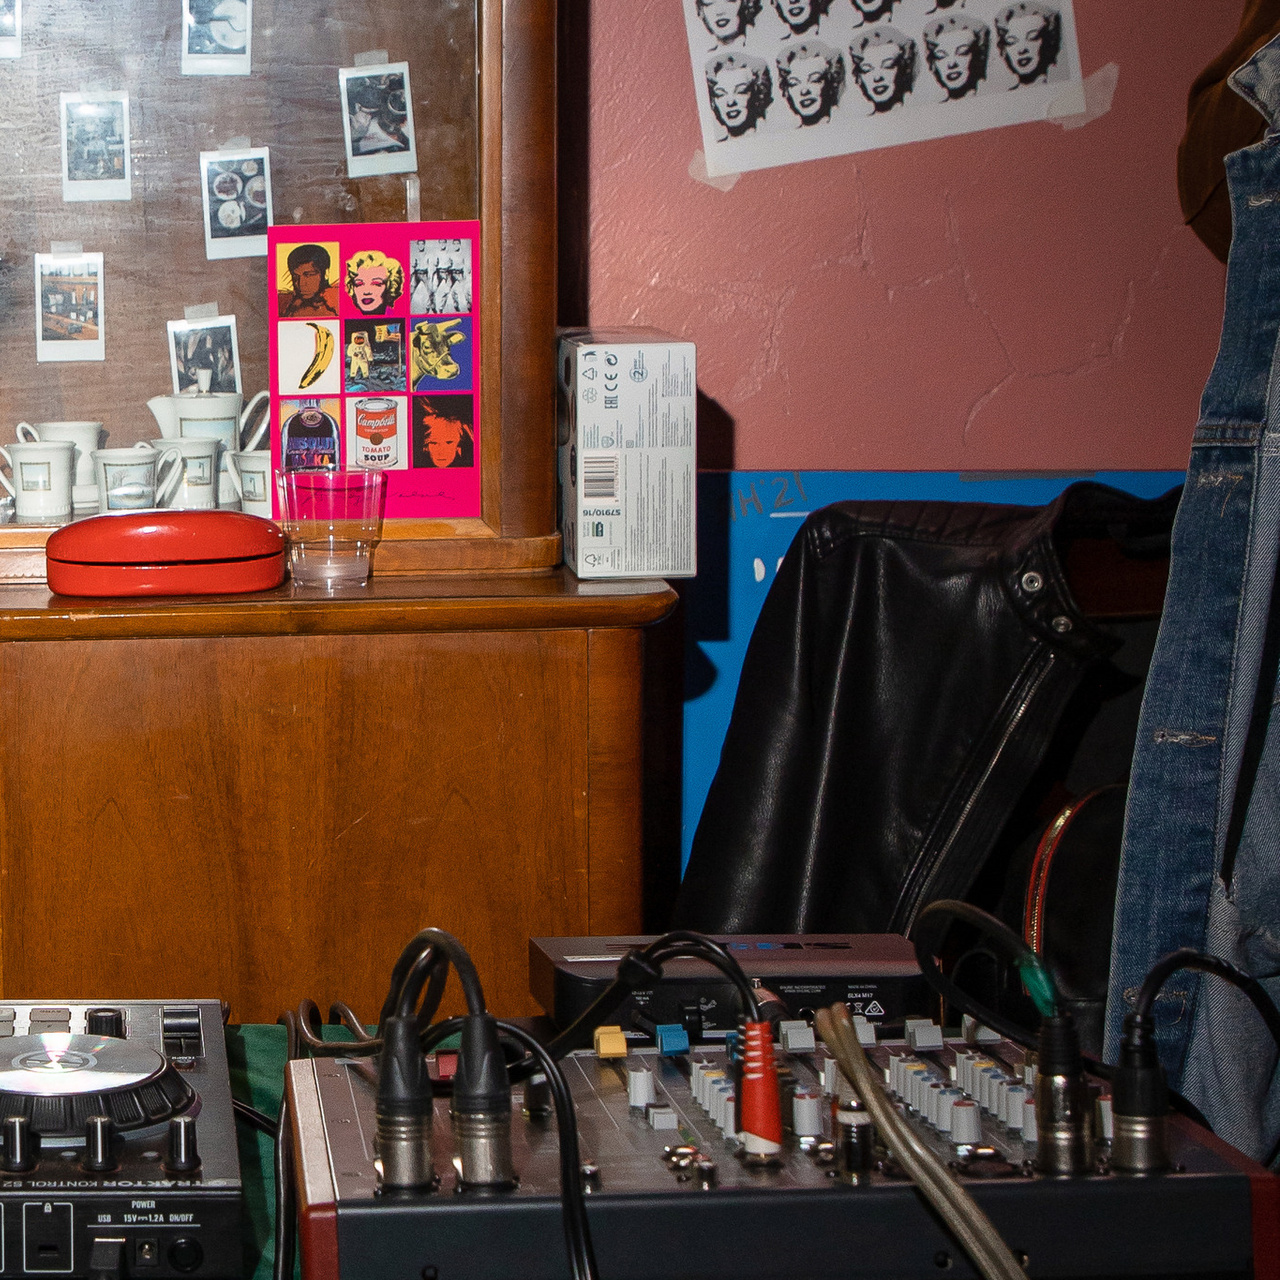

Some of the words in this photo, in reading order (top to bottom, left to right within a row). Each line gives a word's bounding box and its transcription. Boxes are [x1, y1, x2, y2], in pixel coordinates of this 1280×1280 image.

[362, 445, 392, 453] TOMATO
[363, 453, 390, 462] SOUP
[582, 508, 621, 517] 57910/16
[2, 1180, 23, 1188] S2
[26, 1180, 98, 1188] KONTROL
[103, 1180, 202, 1188] TRAKTOR
[131, 1200, 156, 1209] POWER
[97, 1214, 112, 1223] USB
[169, 1213, 194, 1223] ON/OFF
